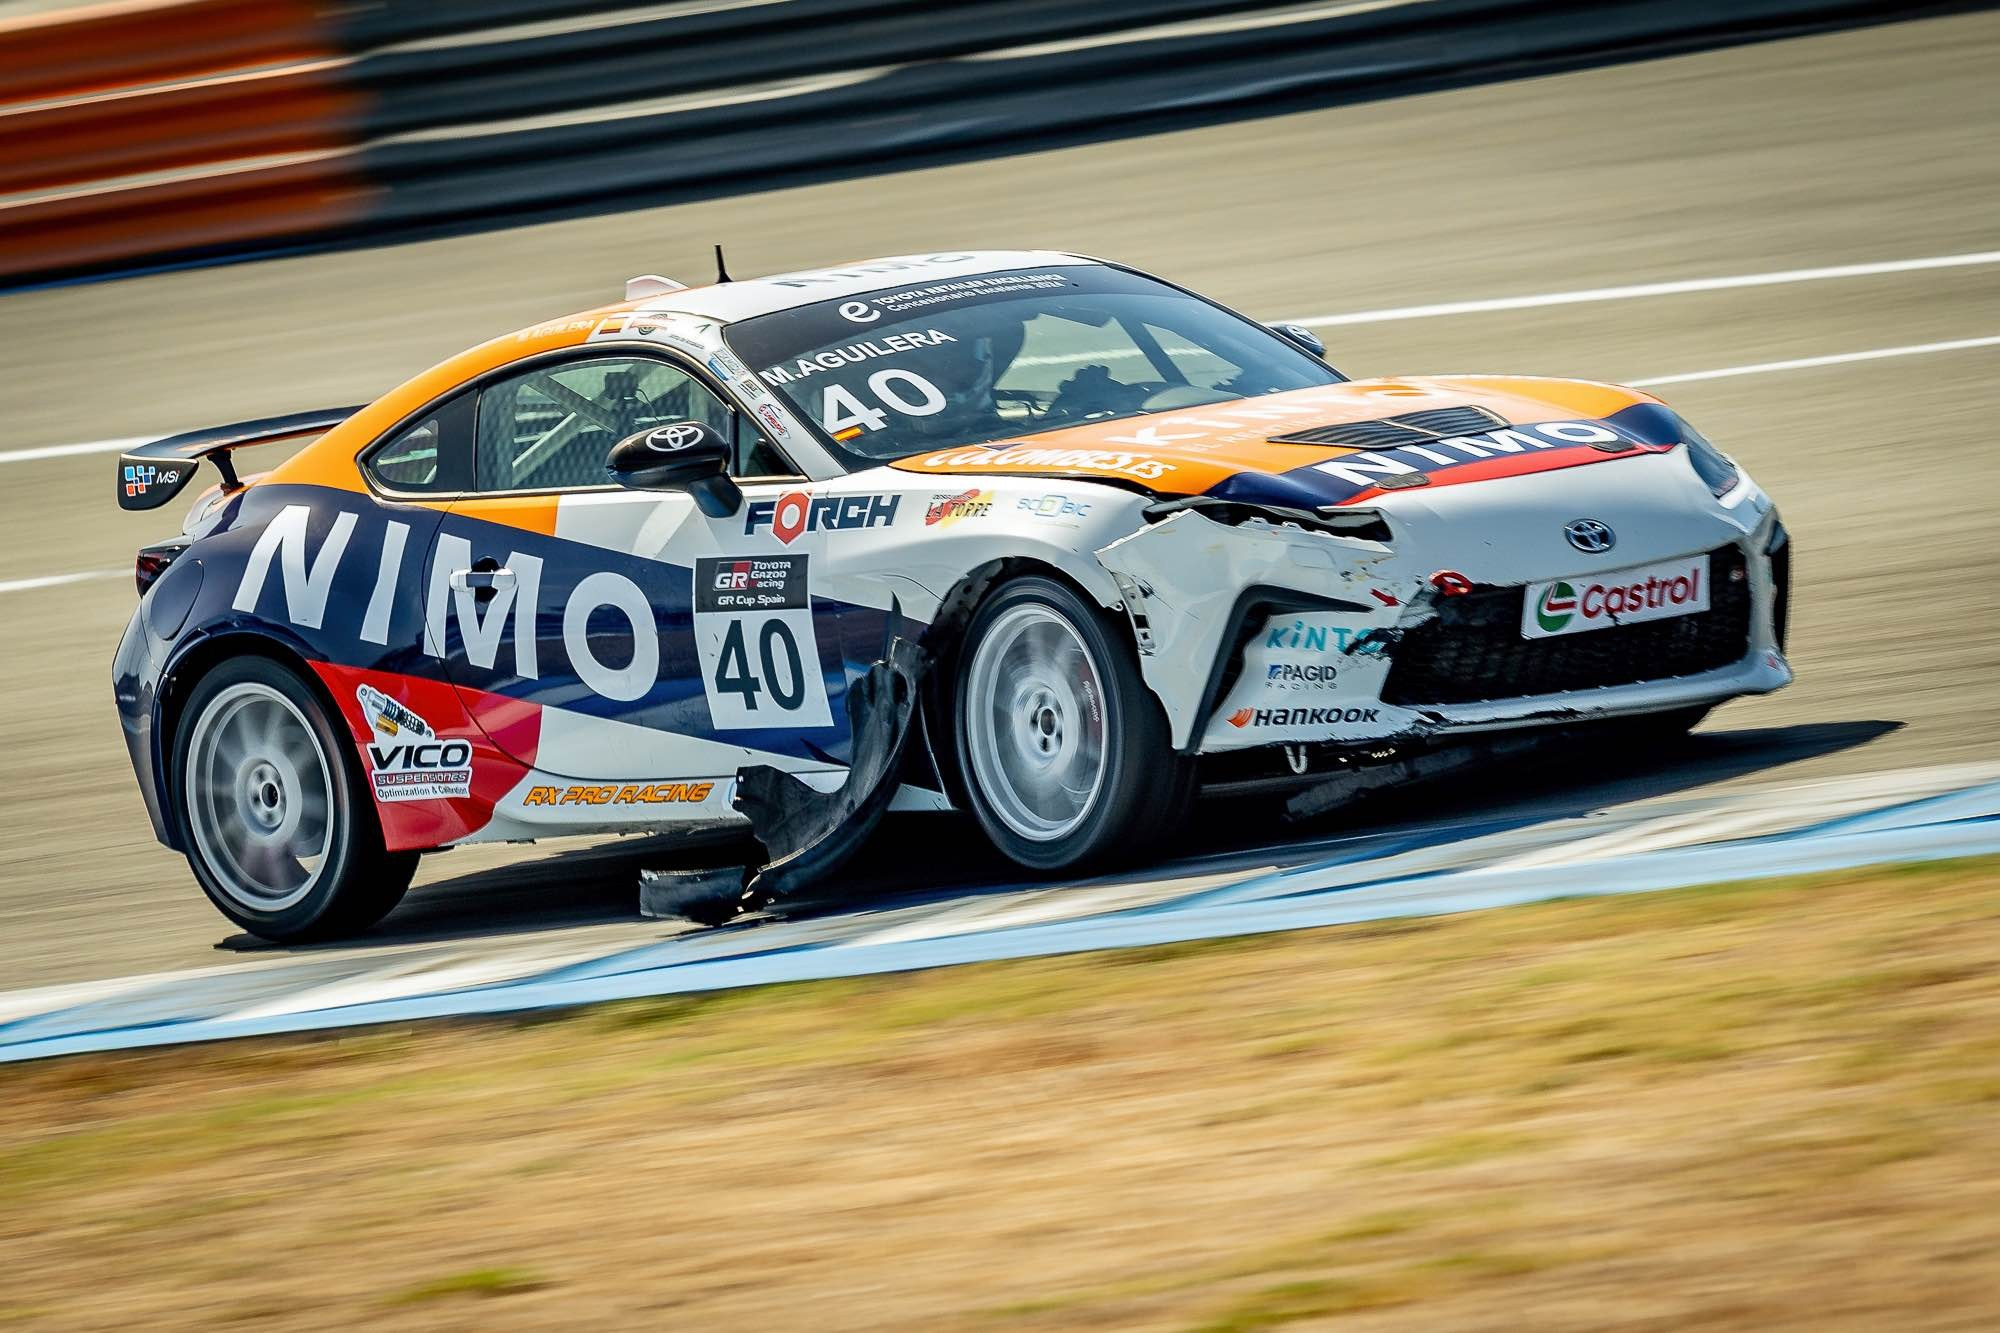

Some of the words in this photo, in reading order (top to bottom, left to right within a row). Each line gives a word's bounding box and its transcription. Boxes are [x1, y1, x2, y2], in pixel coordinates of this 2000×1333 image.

[870, 289, 926, 306] TOYOTA
[925, 279, 985, 297] RETAILER
[983, 273, 1069, 287] EXCELLENCE
[758, 328, 958, 387] M.AGUILERA
[822, 368, 948, 434] 40
[1312, 422, 1619, 487] NIMO
[751, 570, 787, 579] GAZOO
[753, 561, 791, 570] TOYOTA
[715, 572, 748, 589] GR
[1581, 567, 1701, 620] Castrol
[231, 505, 660, 702] NIMO
[718, 595, 735, 606] GR
[736, 596, 756, 607] Cup
[757, 594, 785, 606] Spain
[715, 618, 806, 711] 40
[1283, 664, 1337, 683] PAGID
[370, 743, 470, 771] VICO
[377, 787, 430, 800] Optimization
[522, 786, 564, 806] RX
[560, 785, 618, 806] PRO
[613, 782, 715, 805] RACING
